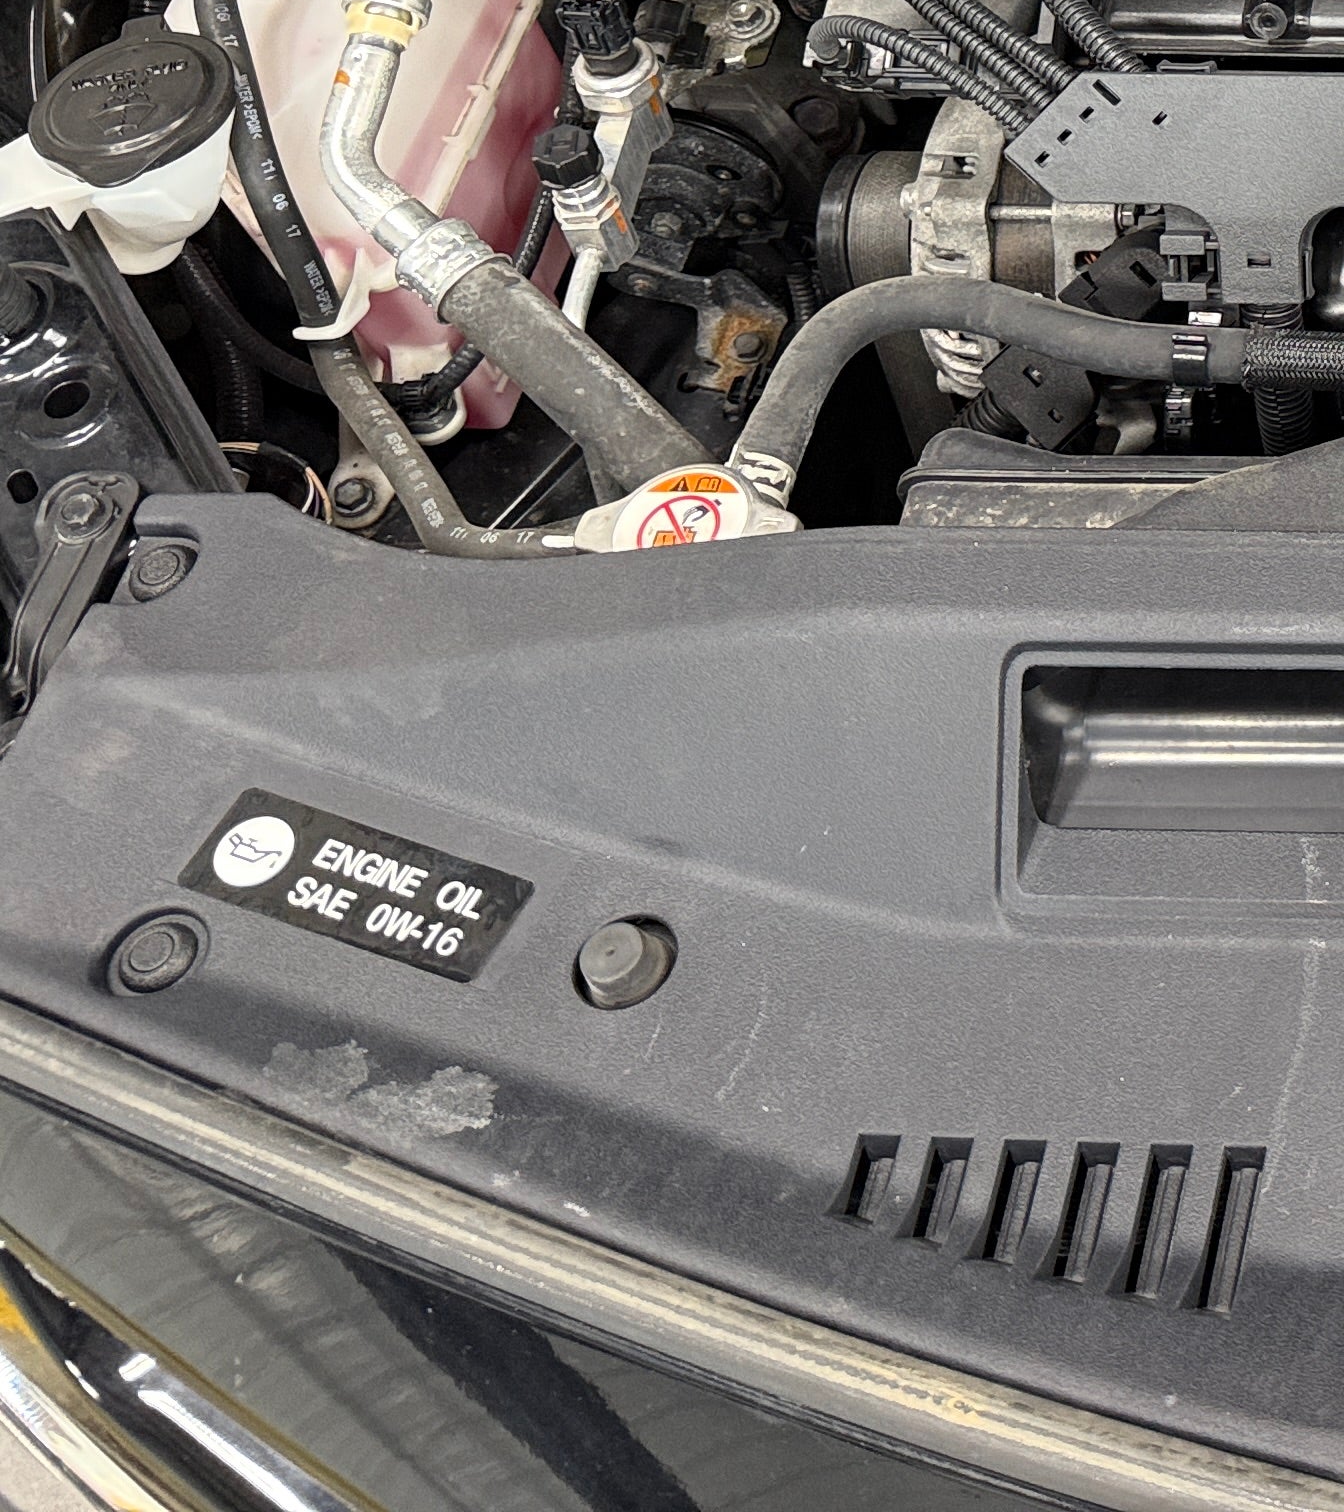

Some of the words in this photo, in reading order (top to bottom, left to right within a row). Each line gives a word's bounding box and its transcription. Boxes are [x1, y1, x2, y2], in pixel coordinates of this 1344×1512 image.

[272, 193, 290, 211] 06
[285, 223, 303, 238] 17
[480, 531, 501, 544] 06
[516, 531, 535, 544] 17
[311, 838, 429, 898] ENGINE
[436, 880, 483, 921] OIL
[287, 876, 358, 921] SAE
[365, 903, 464, 957] 0W-16
